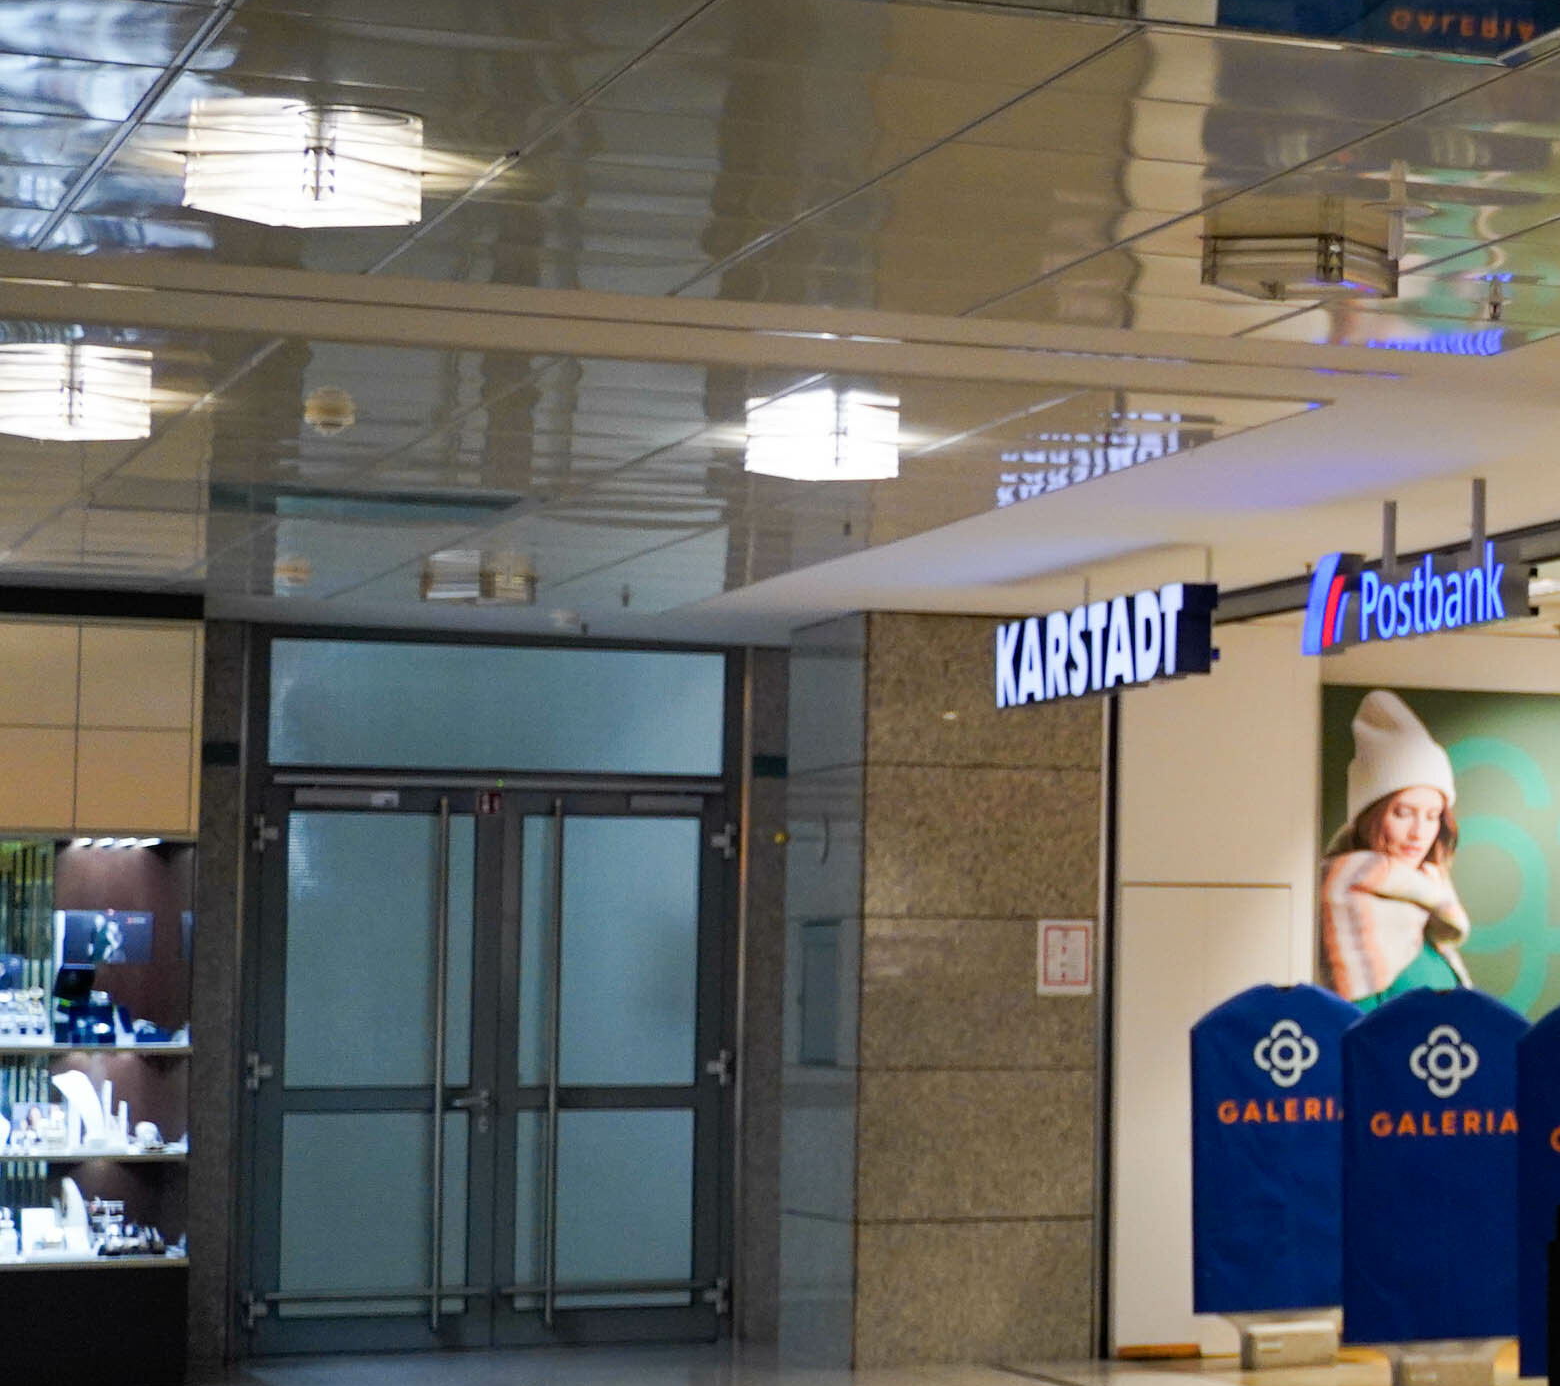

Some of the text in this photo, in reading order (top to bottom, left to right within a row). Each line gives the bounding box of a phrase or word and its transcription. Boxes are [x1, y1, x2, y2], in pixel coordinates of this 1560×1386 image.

[1358, 540, 1507, 642] Postbank
[995, 584, 1183, 708] KARSTADT
[1218, 1097, 1343, 1124] GALERI
[1370, 1109, 1519, 1137] GALERIA
